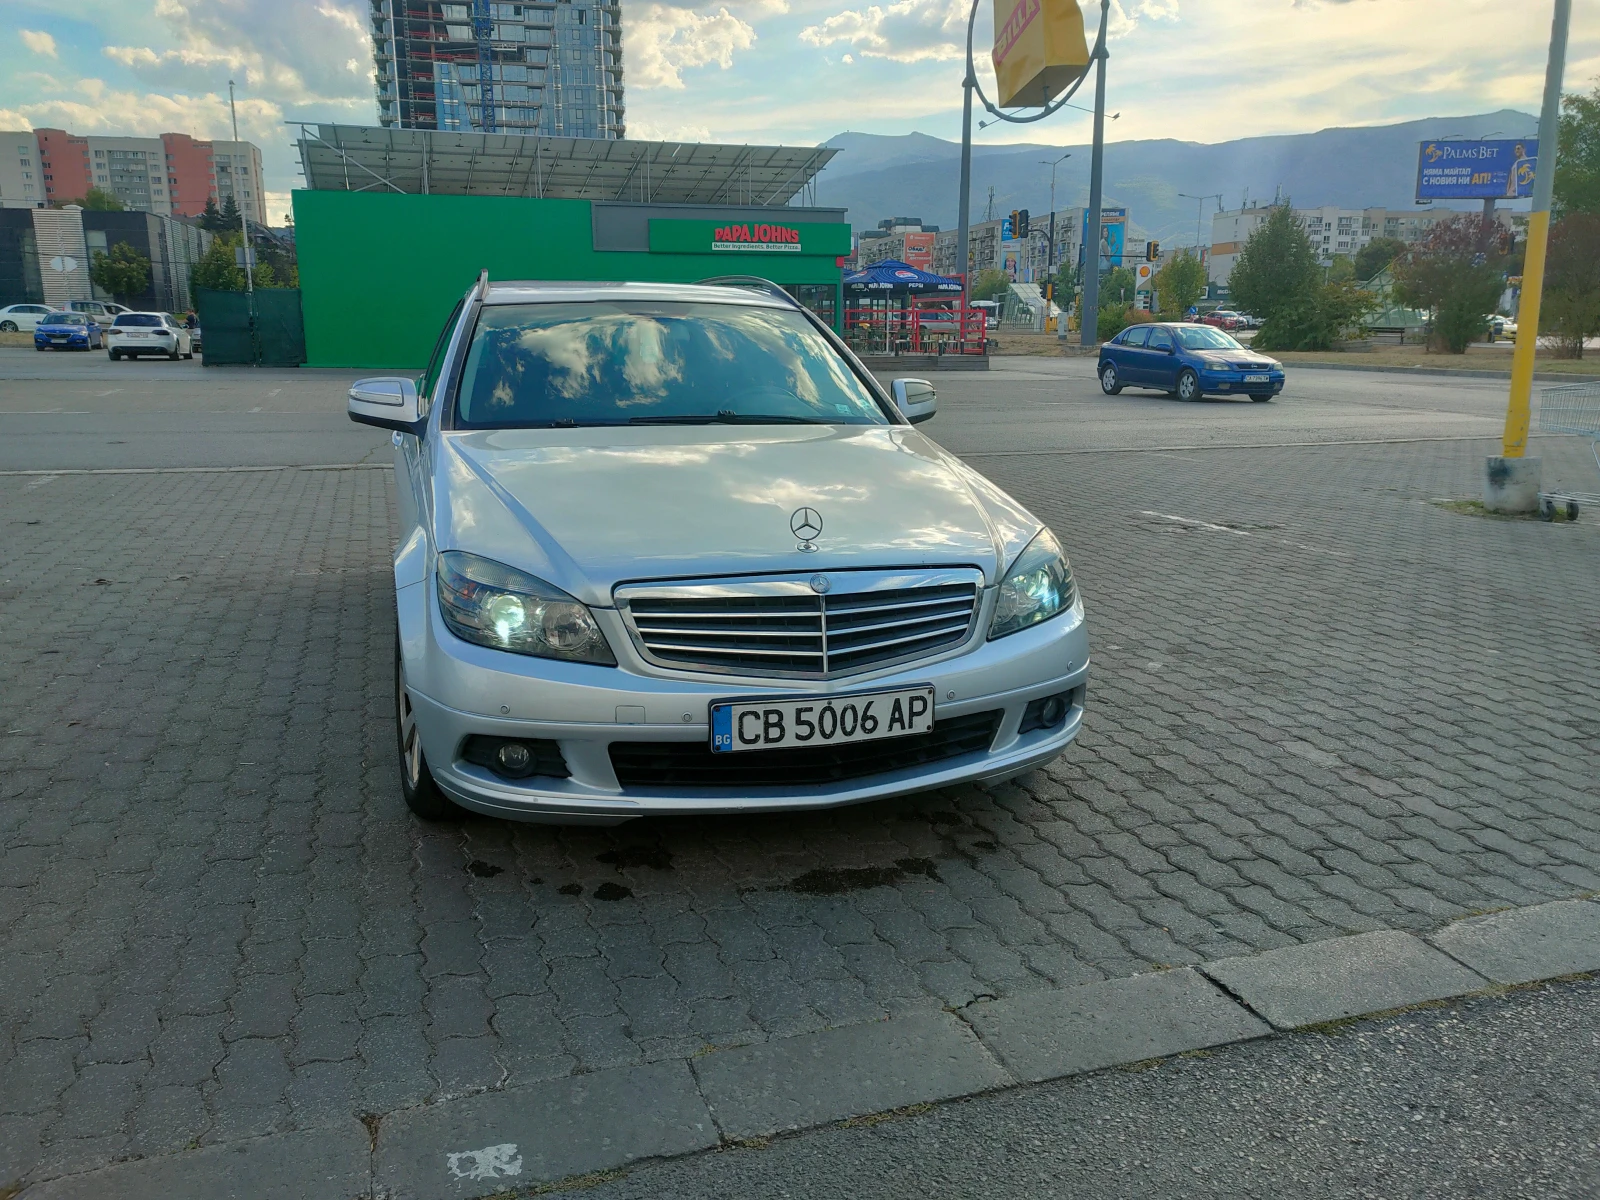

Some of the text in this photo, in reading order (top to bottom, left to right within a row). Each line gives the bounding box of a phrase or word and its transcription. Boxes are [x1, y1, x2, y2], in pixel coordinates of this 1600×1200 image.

[1423, 166, 1471, 176] НЯМА МАЙТАП
[1422, 177, 1429, 185] С
[1429, 176, 1457, 185] НОВИЯ
[1457, 176, 1470, 185] НИ
[1471, 172, 1492, 185] АП!
[715, 224, 799, 242] PAPA JOHNS
[732, 243, 765, 251] Ingredients.
[737, 695, 928, 745] CB 5006 AP
[715, 734, 731, 746] BG
